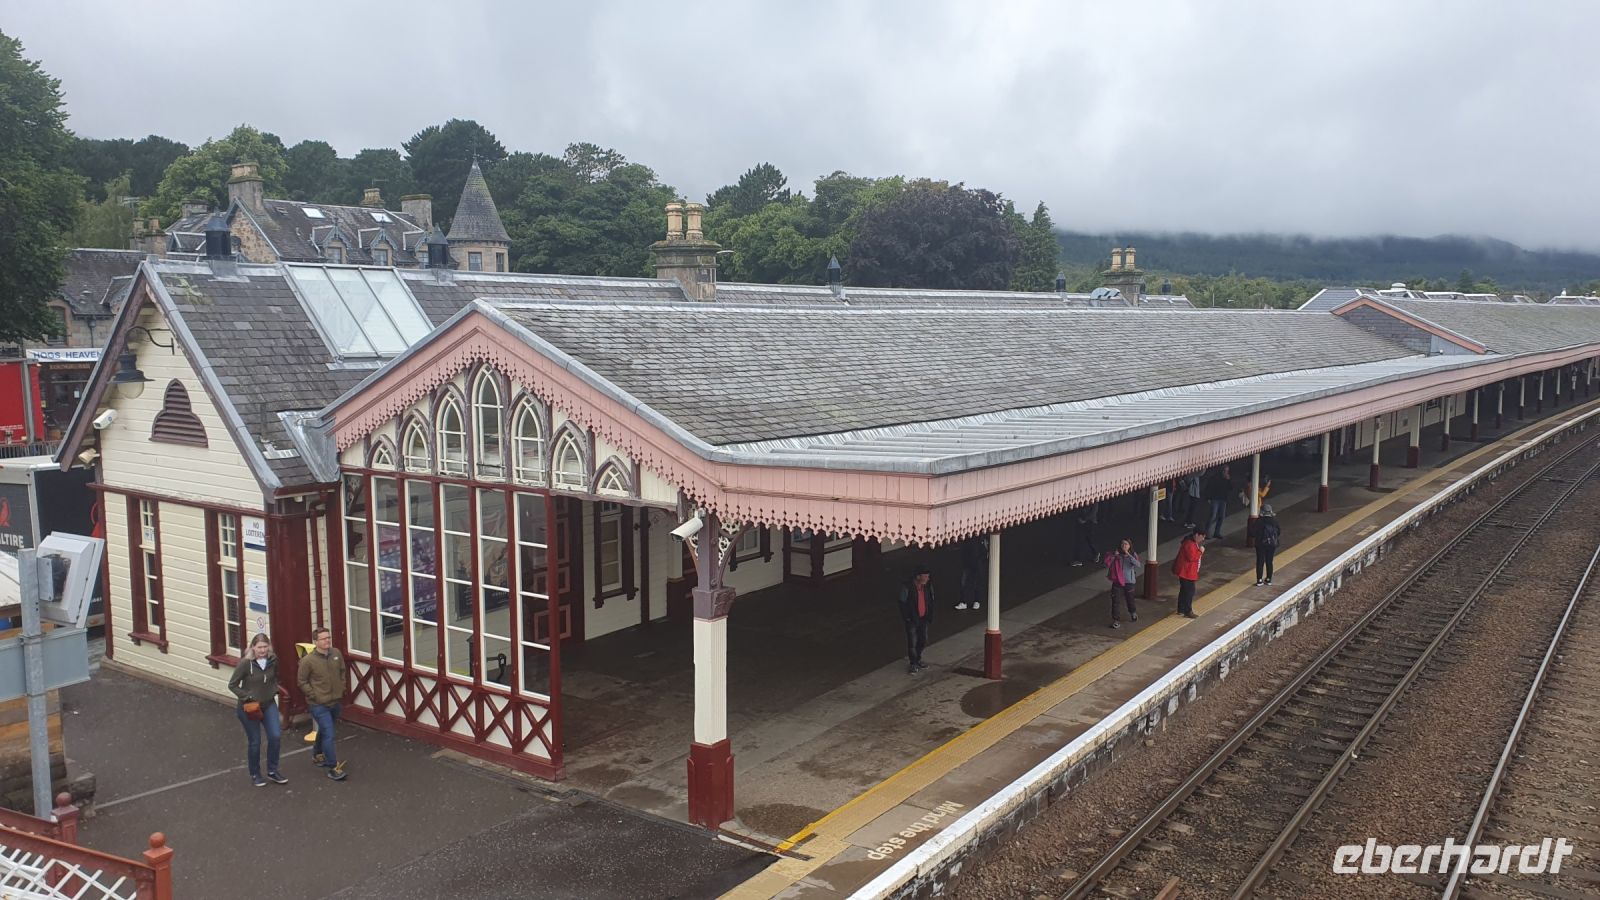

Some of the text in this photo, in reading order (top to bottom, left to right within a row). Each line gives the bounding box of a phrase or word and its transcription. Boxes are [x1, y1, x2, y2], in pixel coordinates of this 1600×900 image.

[33, 351, 102, 359] HOGS HEAVEN
[252, 521, 260, 529] NO
[867, 800, 965, 860] Mind the step
